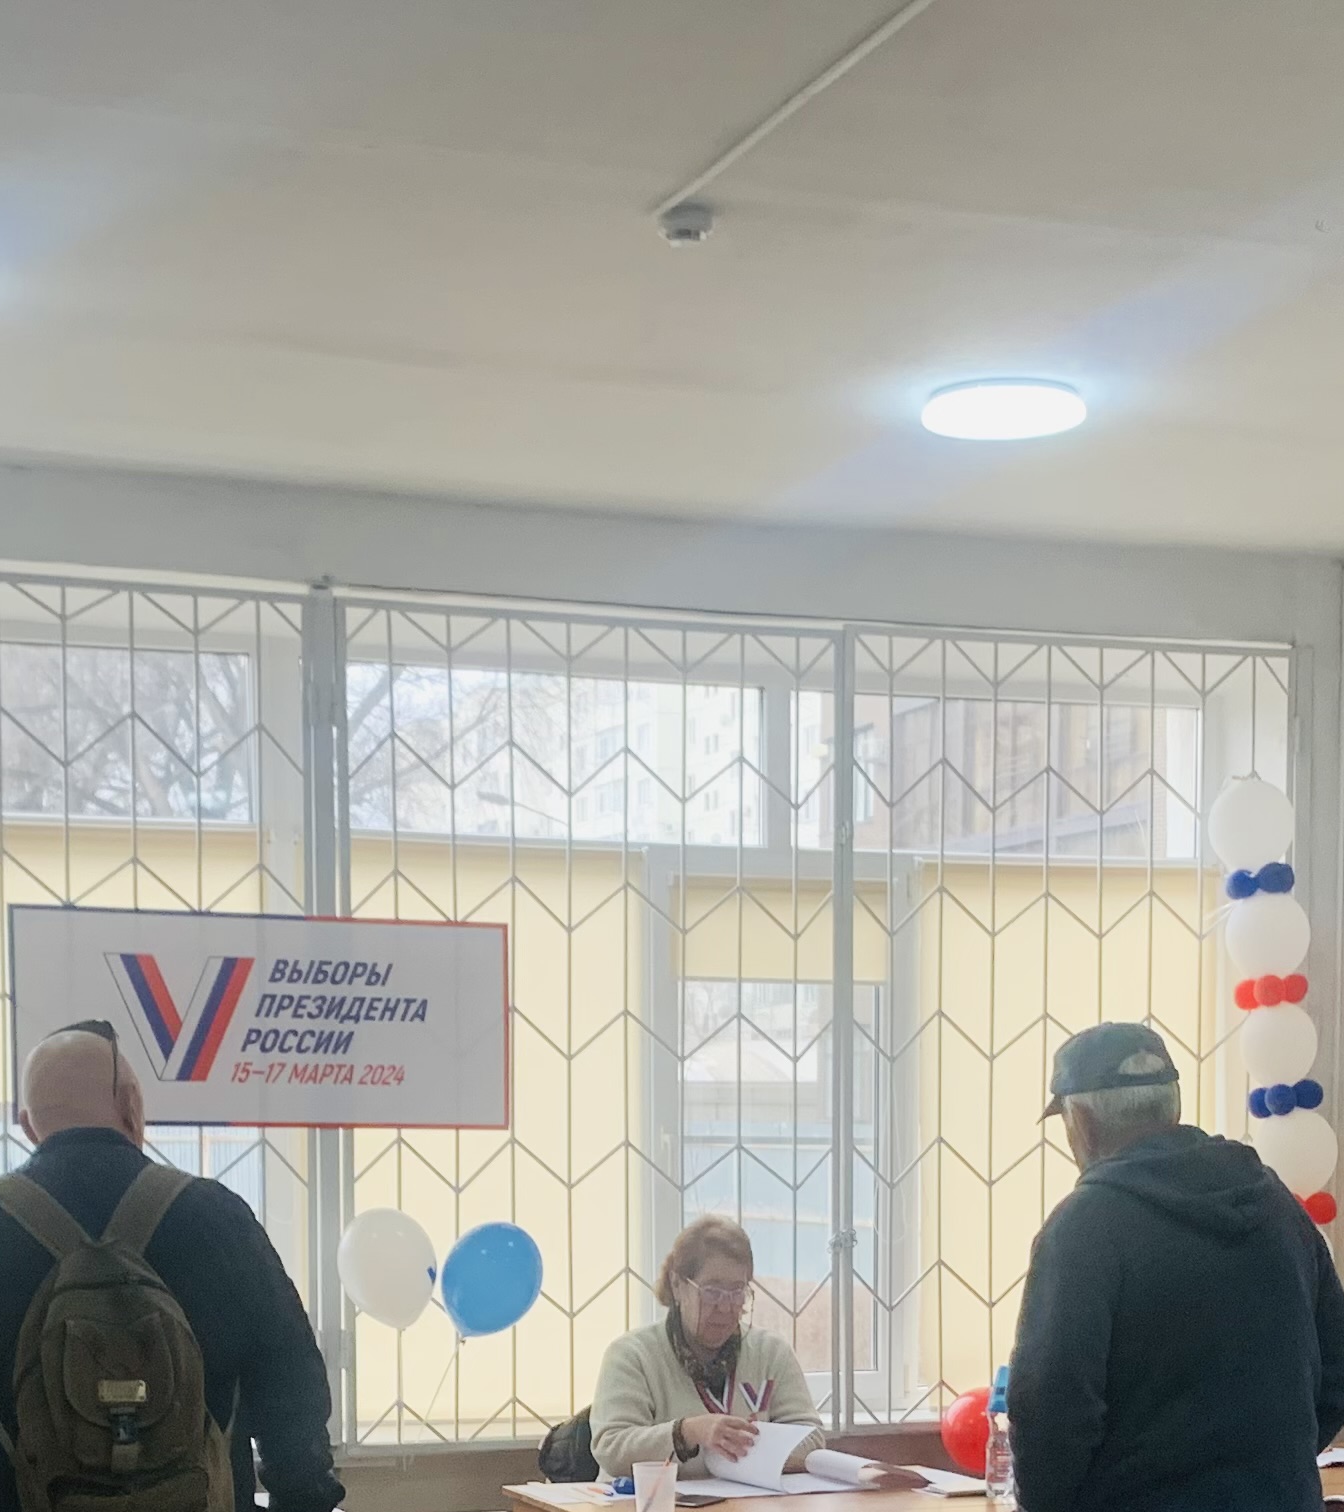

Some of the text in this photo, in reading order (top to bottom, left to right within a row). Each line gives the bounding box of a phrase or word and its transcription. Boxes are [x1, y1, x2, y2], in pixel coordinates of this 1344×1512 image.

[268, 958, 393, 987] ВЫБОРЫ
[254, 993, 429, 1024] ПРЕЗИДЕНТА
[240, 1028, 355, 1055] РОССИИ
[288, 1063, 355, 1085] МАРТА
[357, 1064, 406, 1086] 2024
